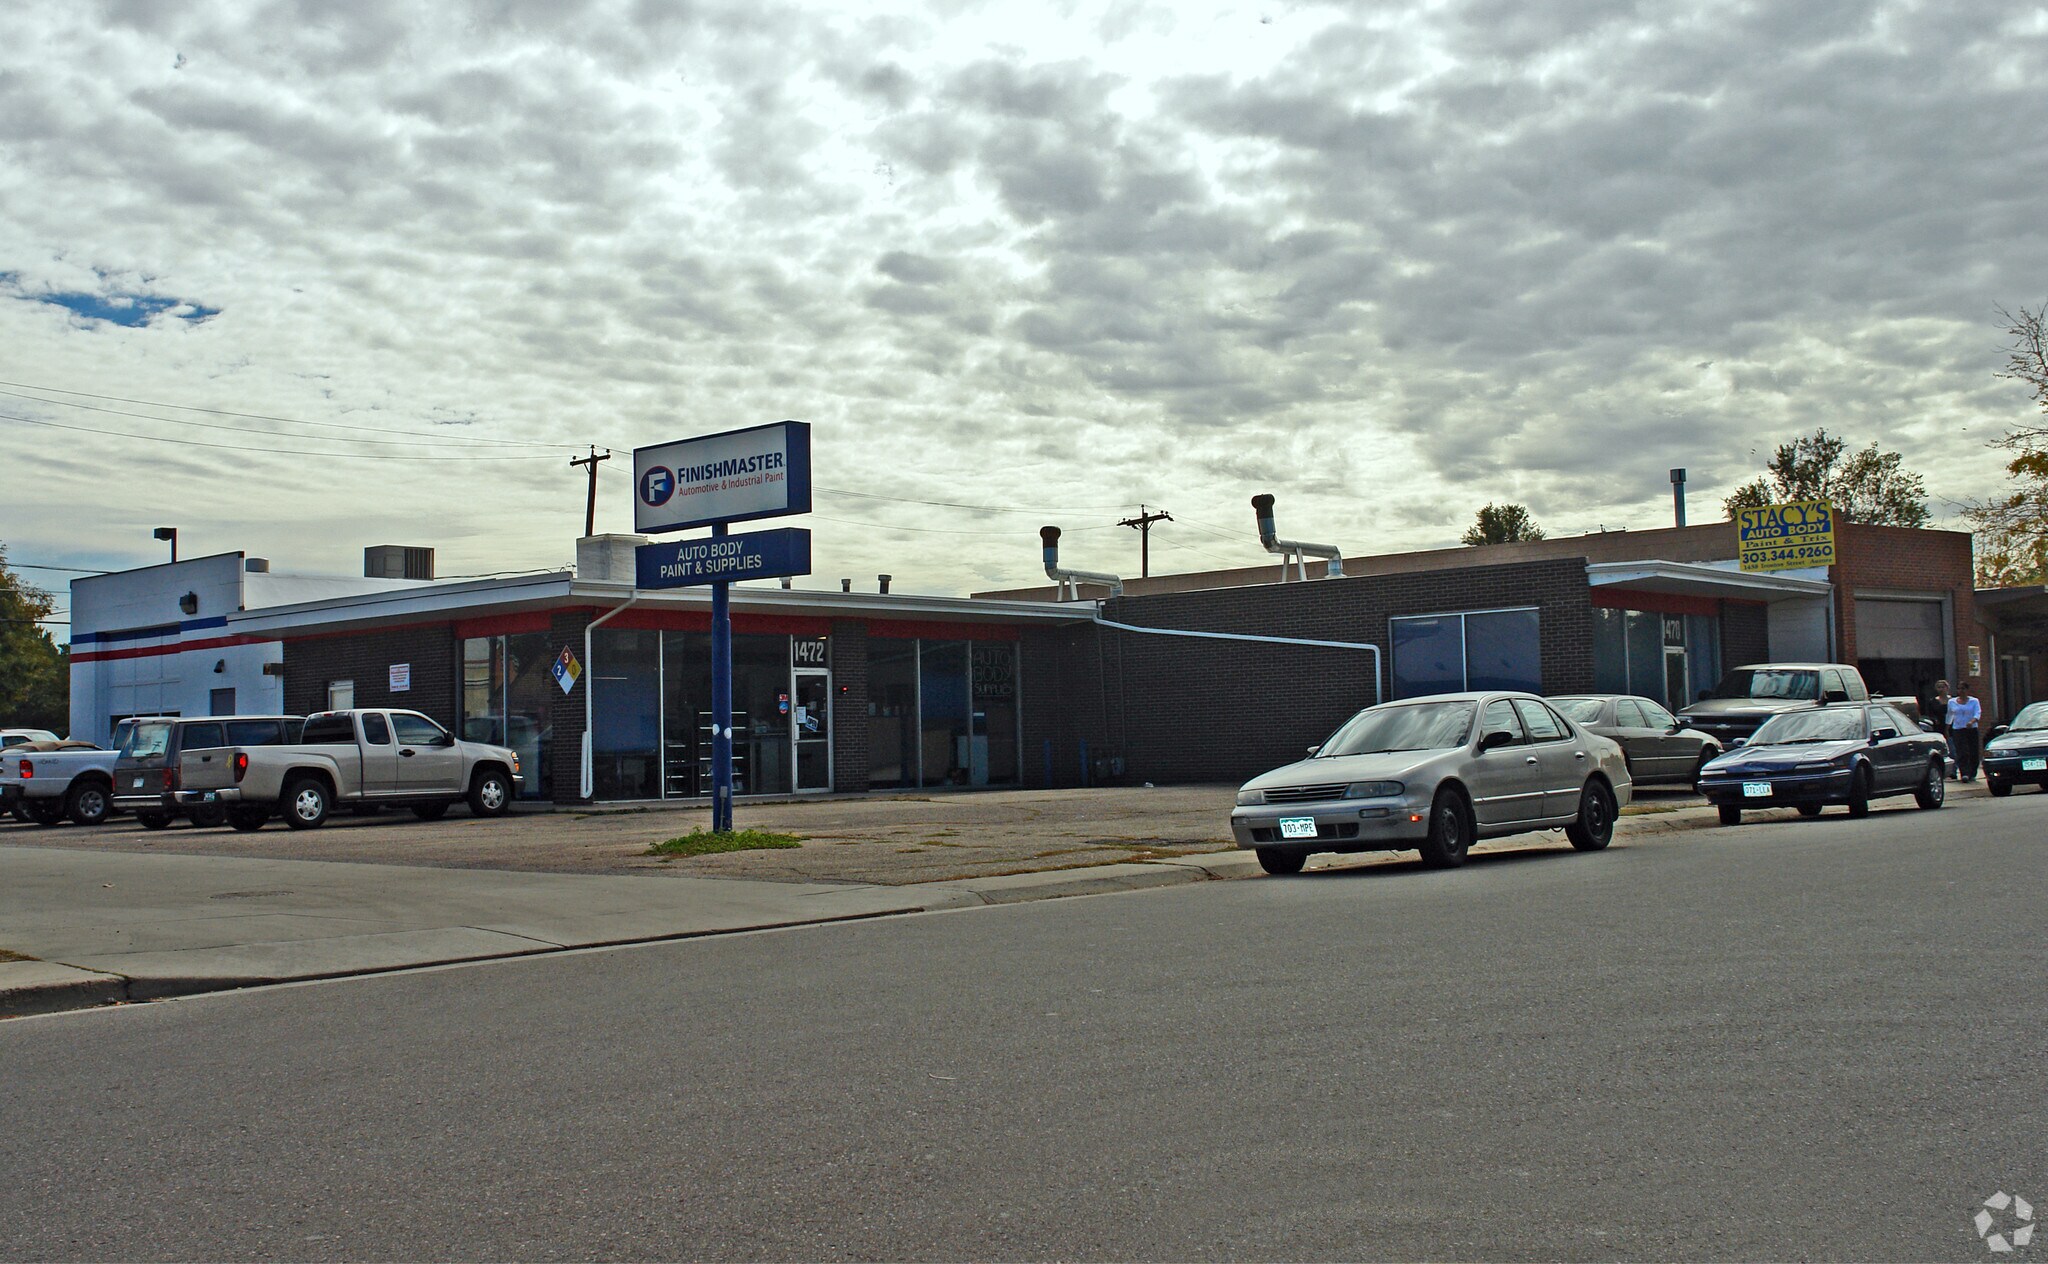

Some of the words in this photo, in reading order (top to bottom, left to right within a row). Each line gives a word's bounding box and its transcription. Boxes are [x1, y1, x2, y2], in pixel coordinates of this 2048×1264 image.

[677, 452, 783, 484] FINISHMASTER
[679, 483, 719, 497] Automotive
[721, 480, 727, 490] &
[729, 474, 763, 489] Industrial
[765, 472, 784, 483] Paint
[1741, 502, 1829, 530] STACY'S
[1745, 540, 1777, 548] Paint
[1802, 535, 1828, 543] Trix
[1747, 528, 1782, 540] AUTO
[1788, 523, 1825, 535] BODY
[677, 546, 708, 562] AUTO
[711, 541, 744, 558] BODY
[1742, 545, 1832, 564] 303.344.9260
[660, 562, 692, 579] PAINT
[695, 560, 703, 575] &
[705, 554, 762, 573] SUPPLIES
[564, 652, 569, 664] 3
[794, 641, 824, 662] 1472
[557, 665, 562, 676] 2
